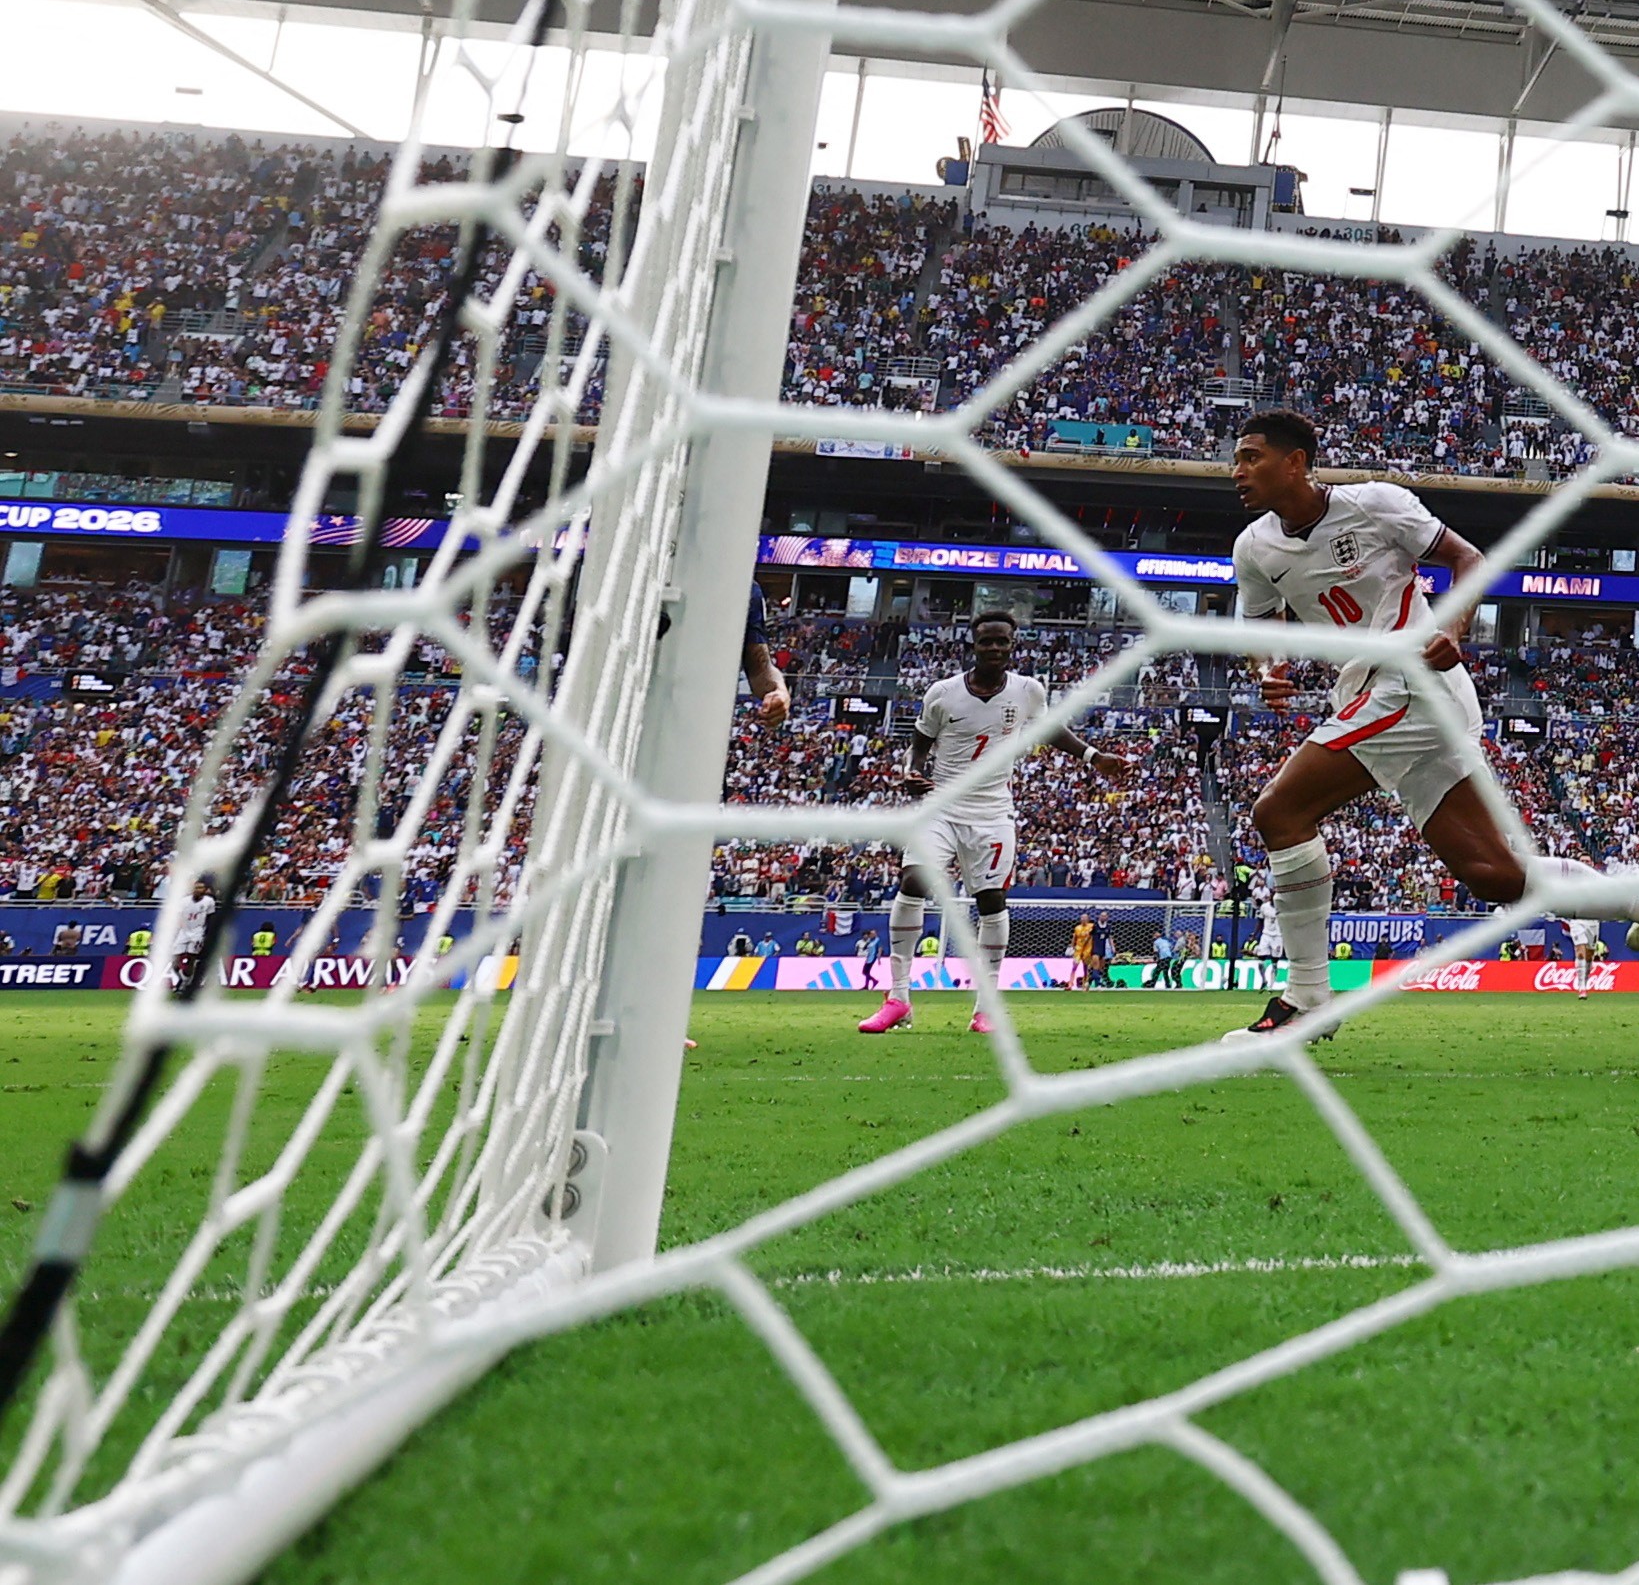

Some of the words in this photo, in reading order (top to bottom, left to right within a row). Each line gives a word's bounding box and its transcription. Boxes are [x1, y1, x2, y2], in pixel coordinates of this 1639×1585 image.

[52, 507, 161, 533] 2026
[893, 547, 999, 568] BRONZE
[1003, 551, 1079, 573] FINAL
[1135, 558, 1234, 582] #FIFAWorldCup
[1522, 574, 1600, 597] MIAMI
[1317, 585, 1364, 630] 10
[970, 734, 990, 762] 7
[990, 842, 1004, 871] 7
[0, 964, 92, 984] TREET
